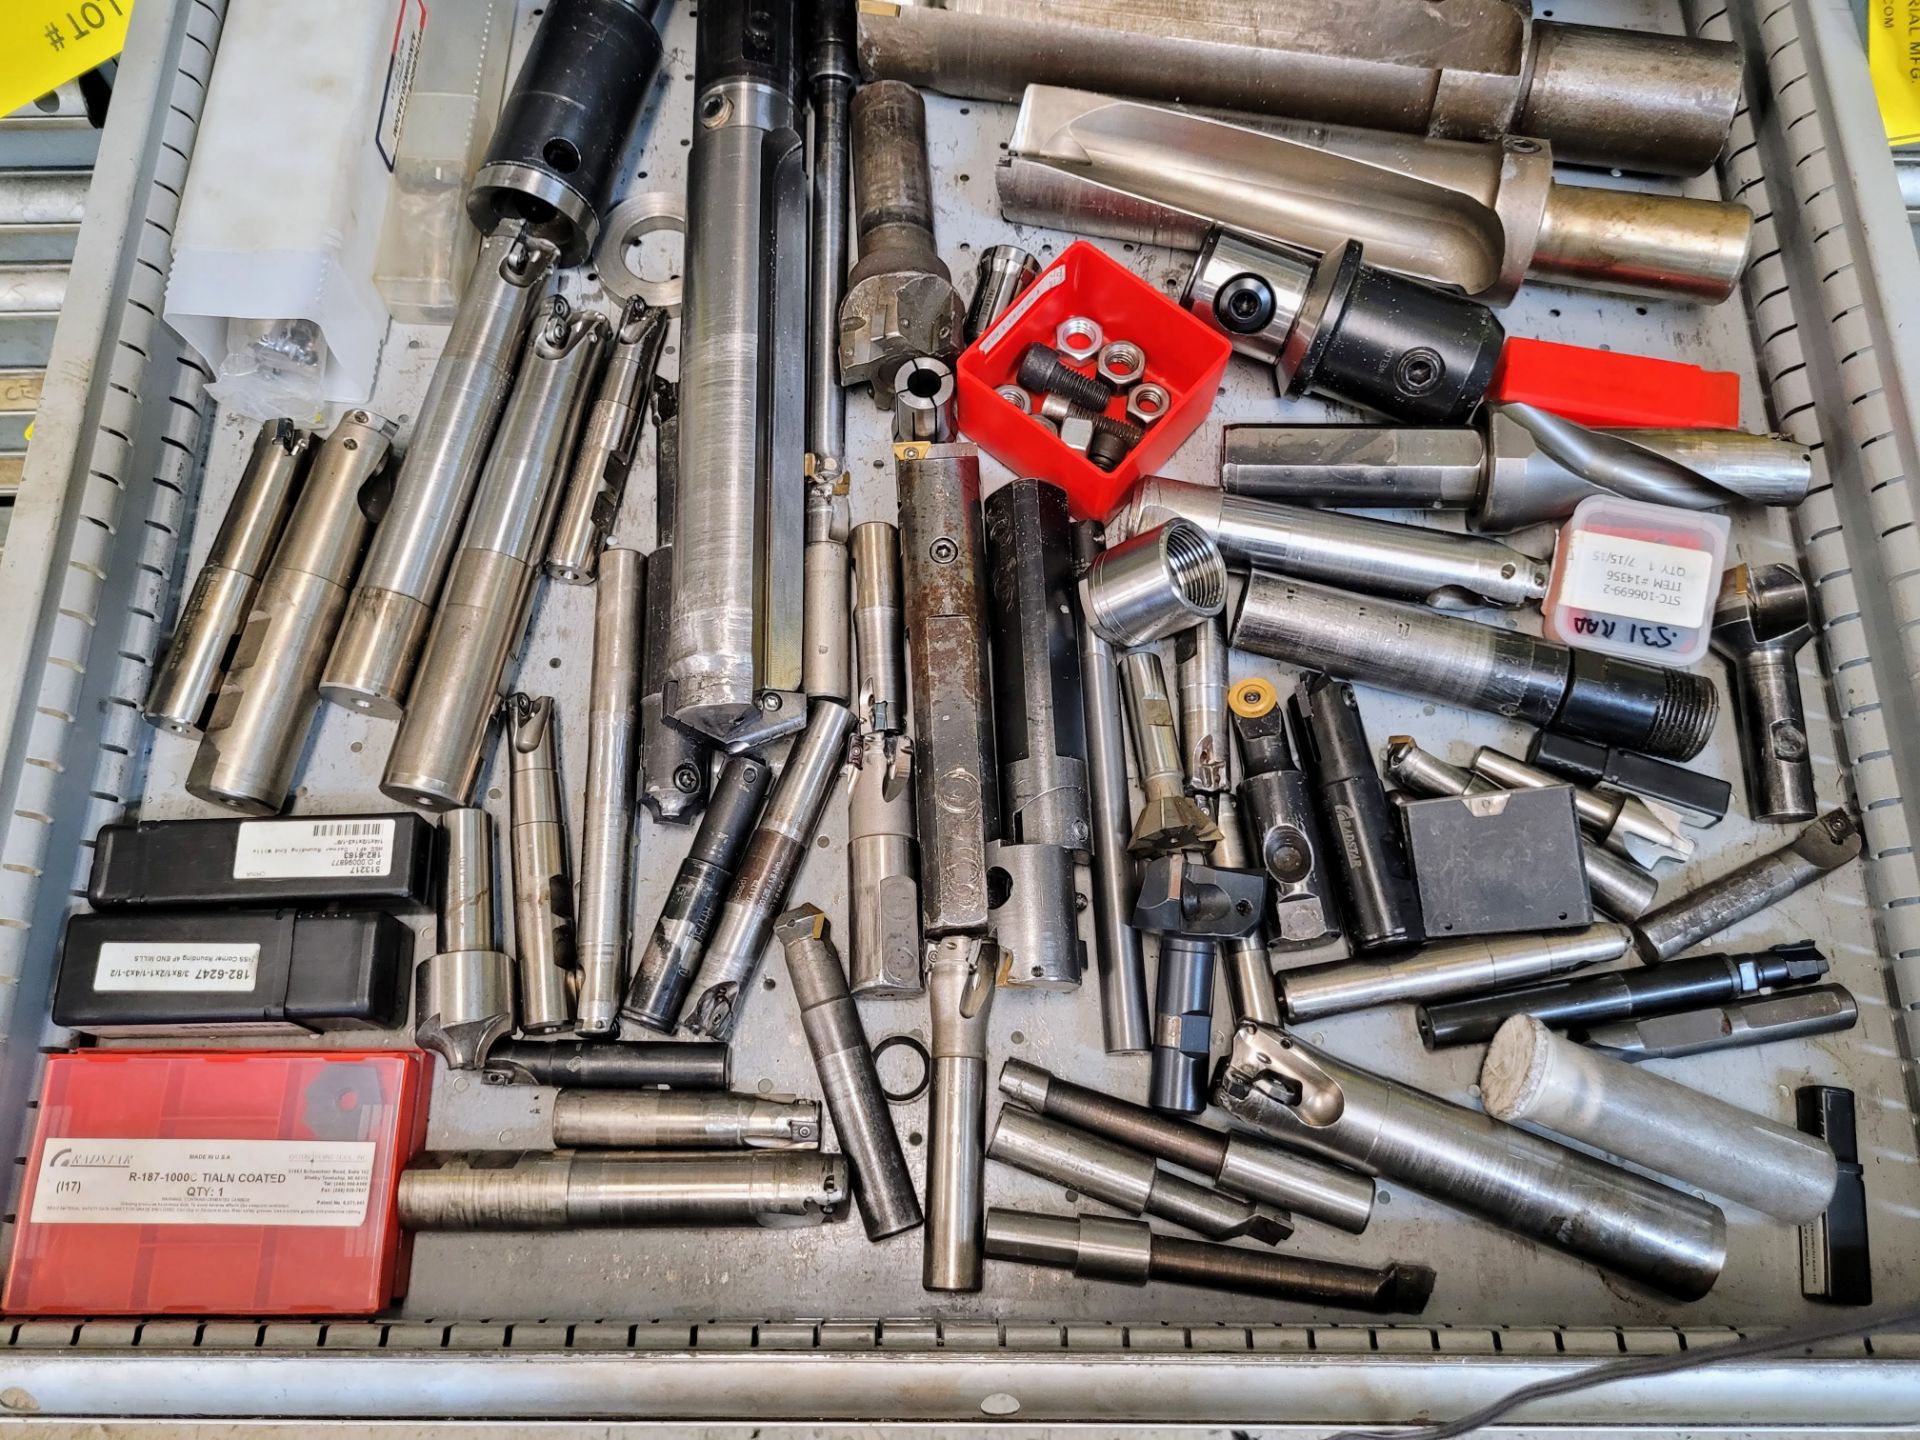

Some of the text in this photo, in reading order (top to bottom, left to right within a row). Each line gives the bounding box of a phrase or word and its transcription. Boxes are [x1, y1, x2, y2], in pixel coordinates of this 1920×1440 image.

[44, 22, 65, 51] #
[1649, 562, 1654, 571] 1
[1661, 566, 1686, 577] QTY
[1606, 570, 1682, 592] ITEM #14356
[1603, 584, 1681, 606] STC-106699-2
[1573, 617, 1678, 648] .531 RAD
[1340, 820, 1362, 869] RADSTAR
[110, 969, 250, 980] 182-6247 3/8x1/2x1-1/4x3-1/2
[71, 1154, 133, 1166] RADSTAR
[202, 1173, 235, 1183] TIALN
[238, 1173, 286, 1184] COATED
[186, 1186, 224, 1197] QTY: 1
